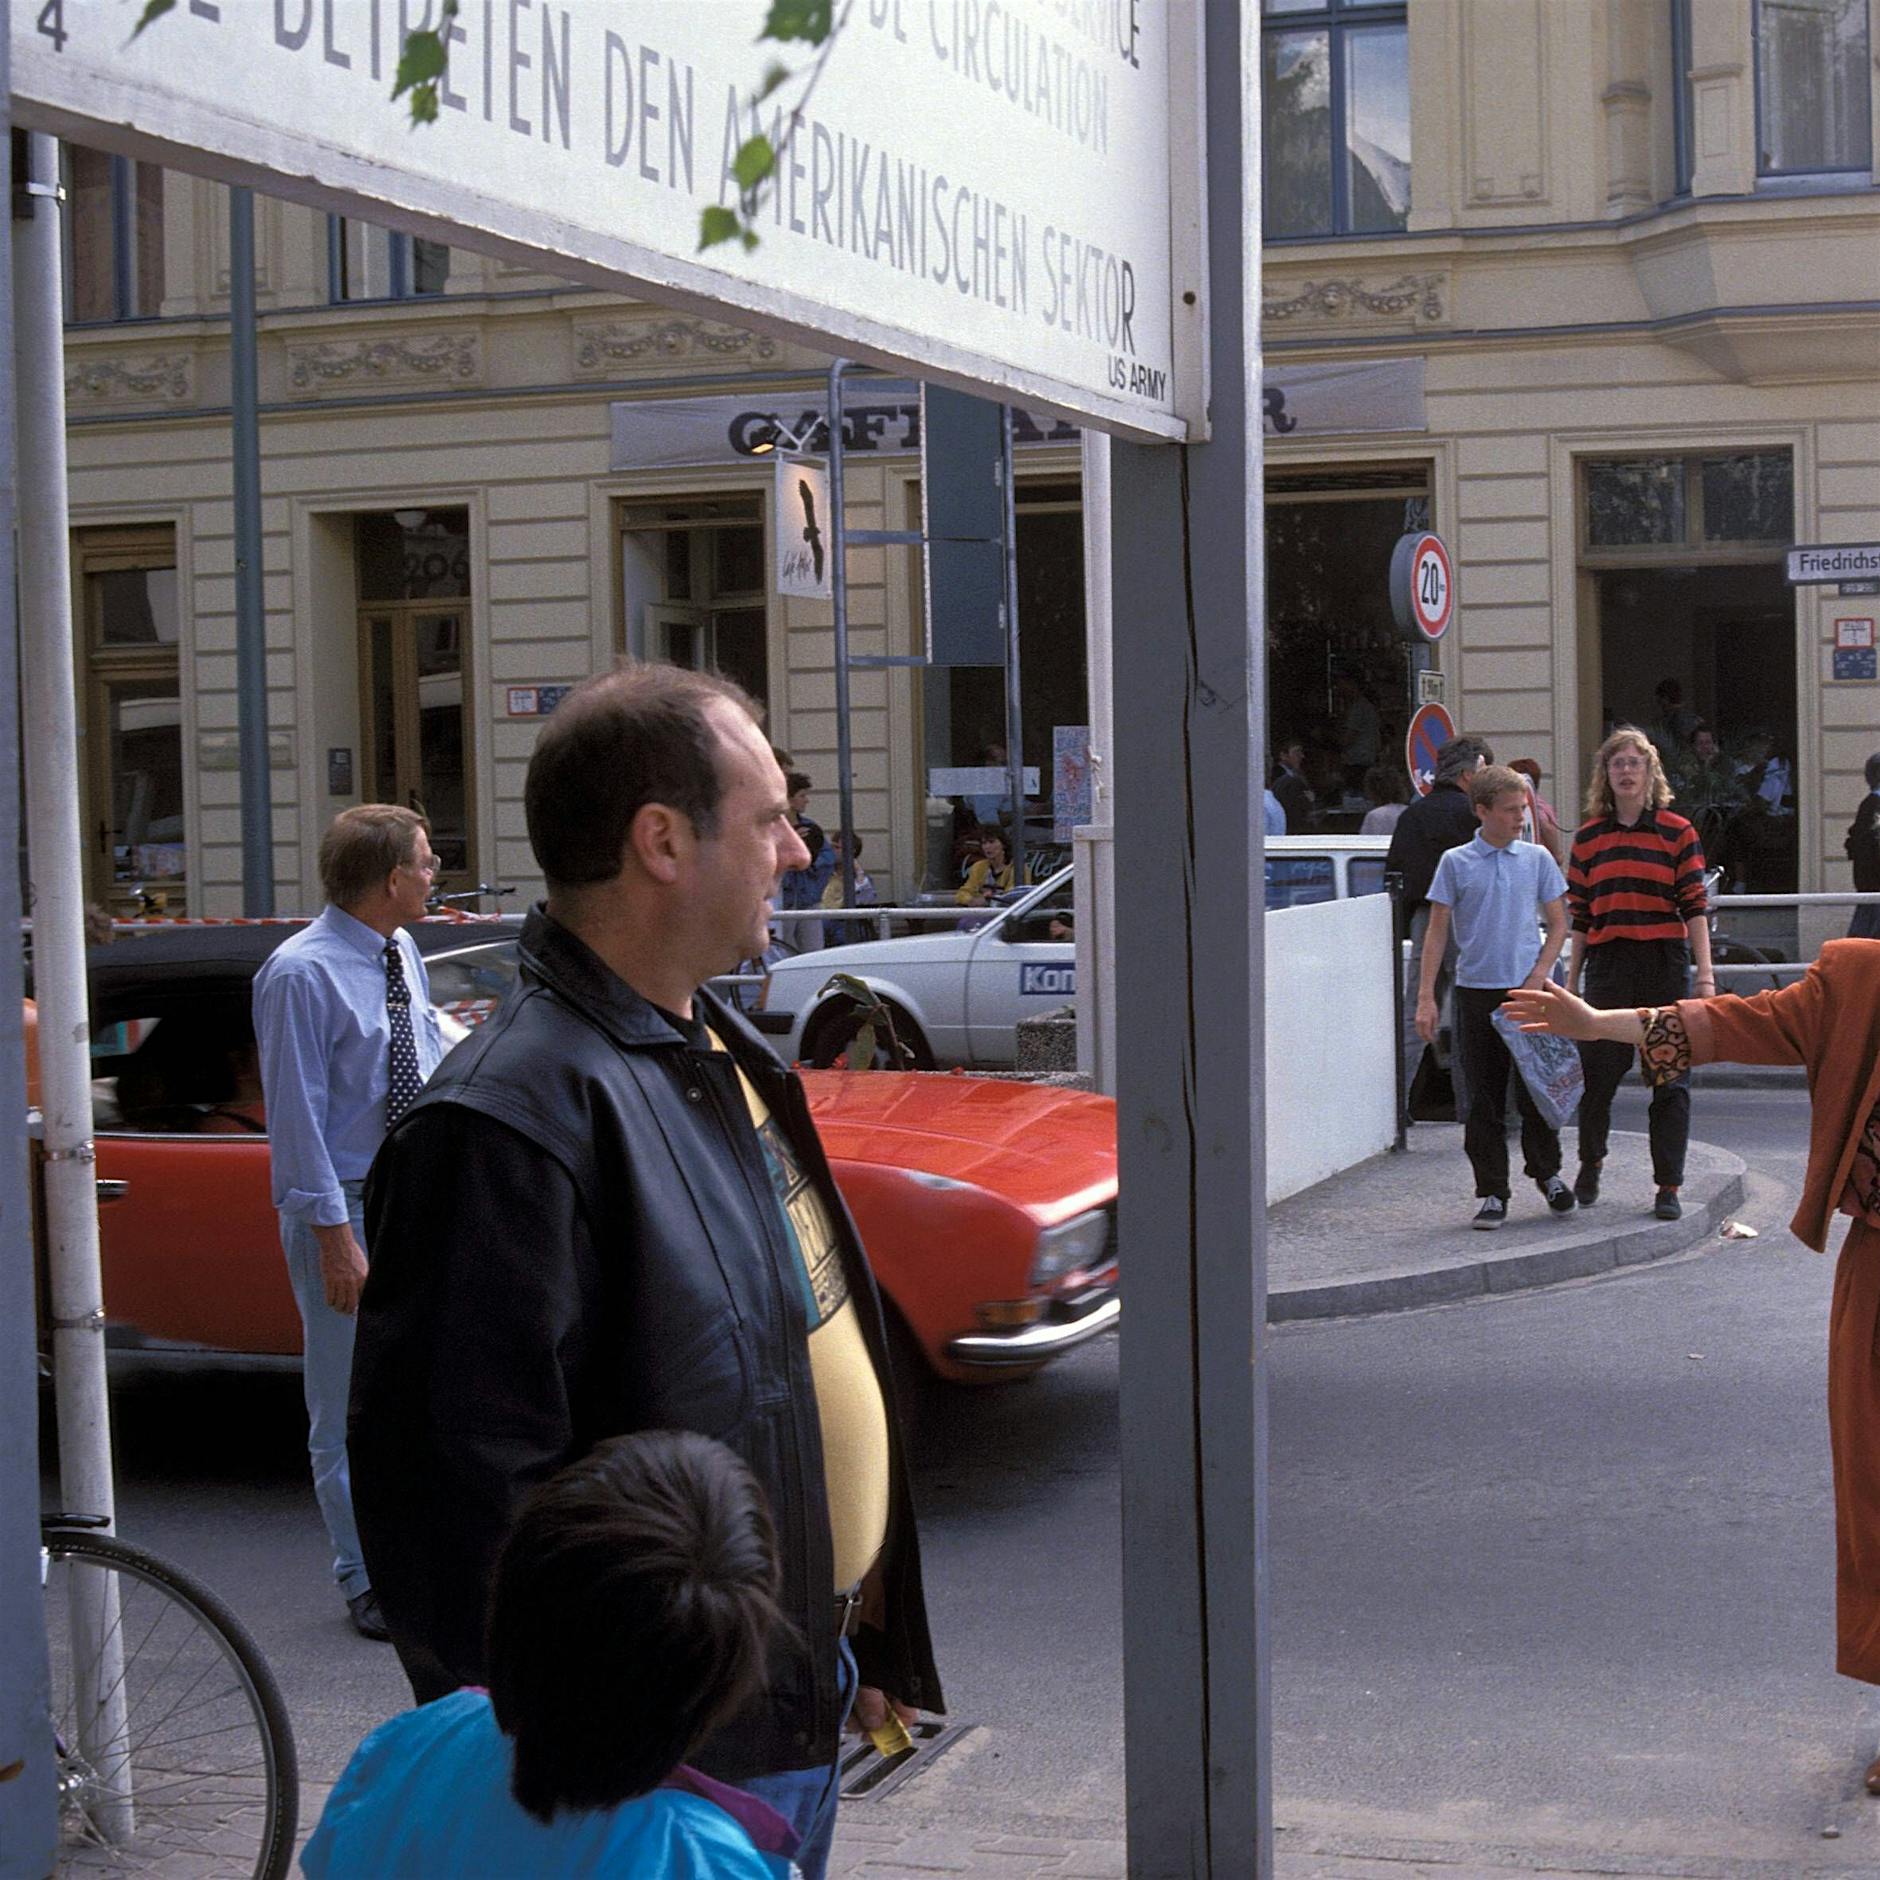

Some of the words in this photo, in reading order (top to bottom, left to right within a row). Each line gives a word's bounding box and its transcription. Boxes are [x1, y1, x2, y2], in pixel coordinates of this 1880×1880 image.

[928, 0, 1108, 154] CIRCULATION
[605, 29, 694, 195] DEN
[1042, 225, 1136, 356] SEKTOR
[1108, 354, 1127, 390] US
[1129, 362, 1167, 401] ARMY
[1420, 560, 1439, 606] 20
